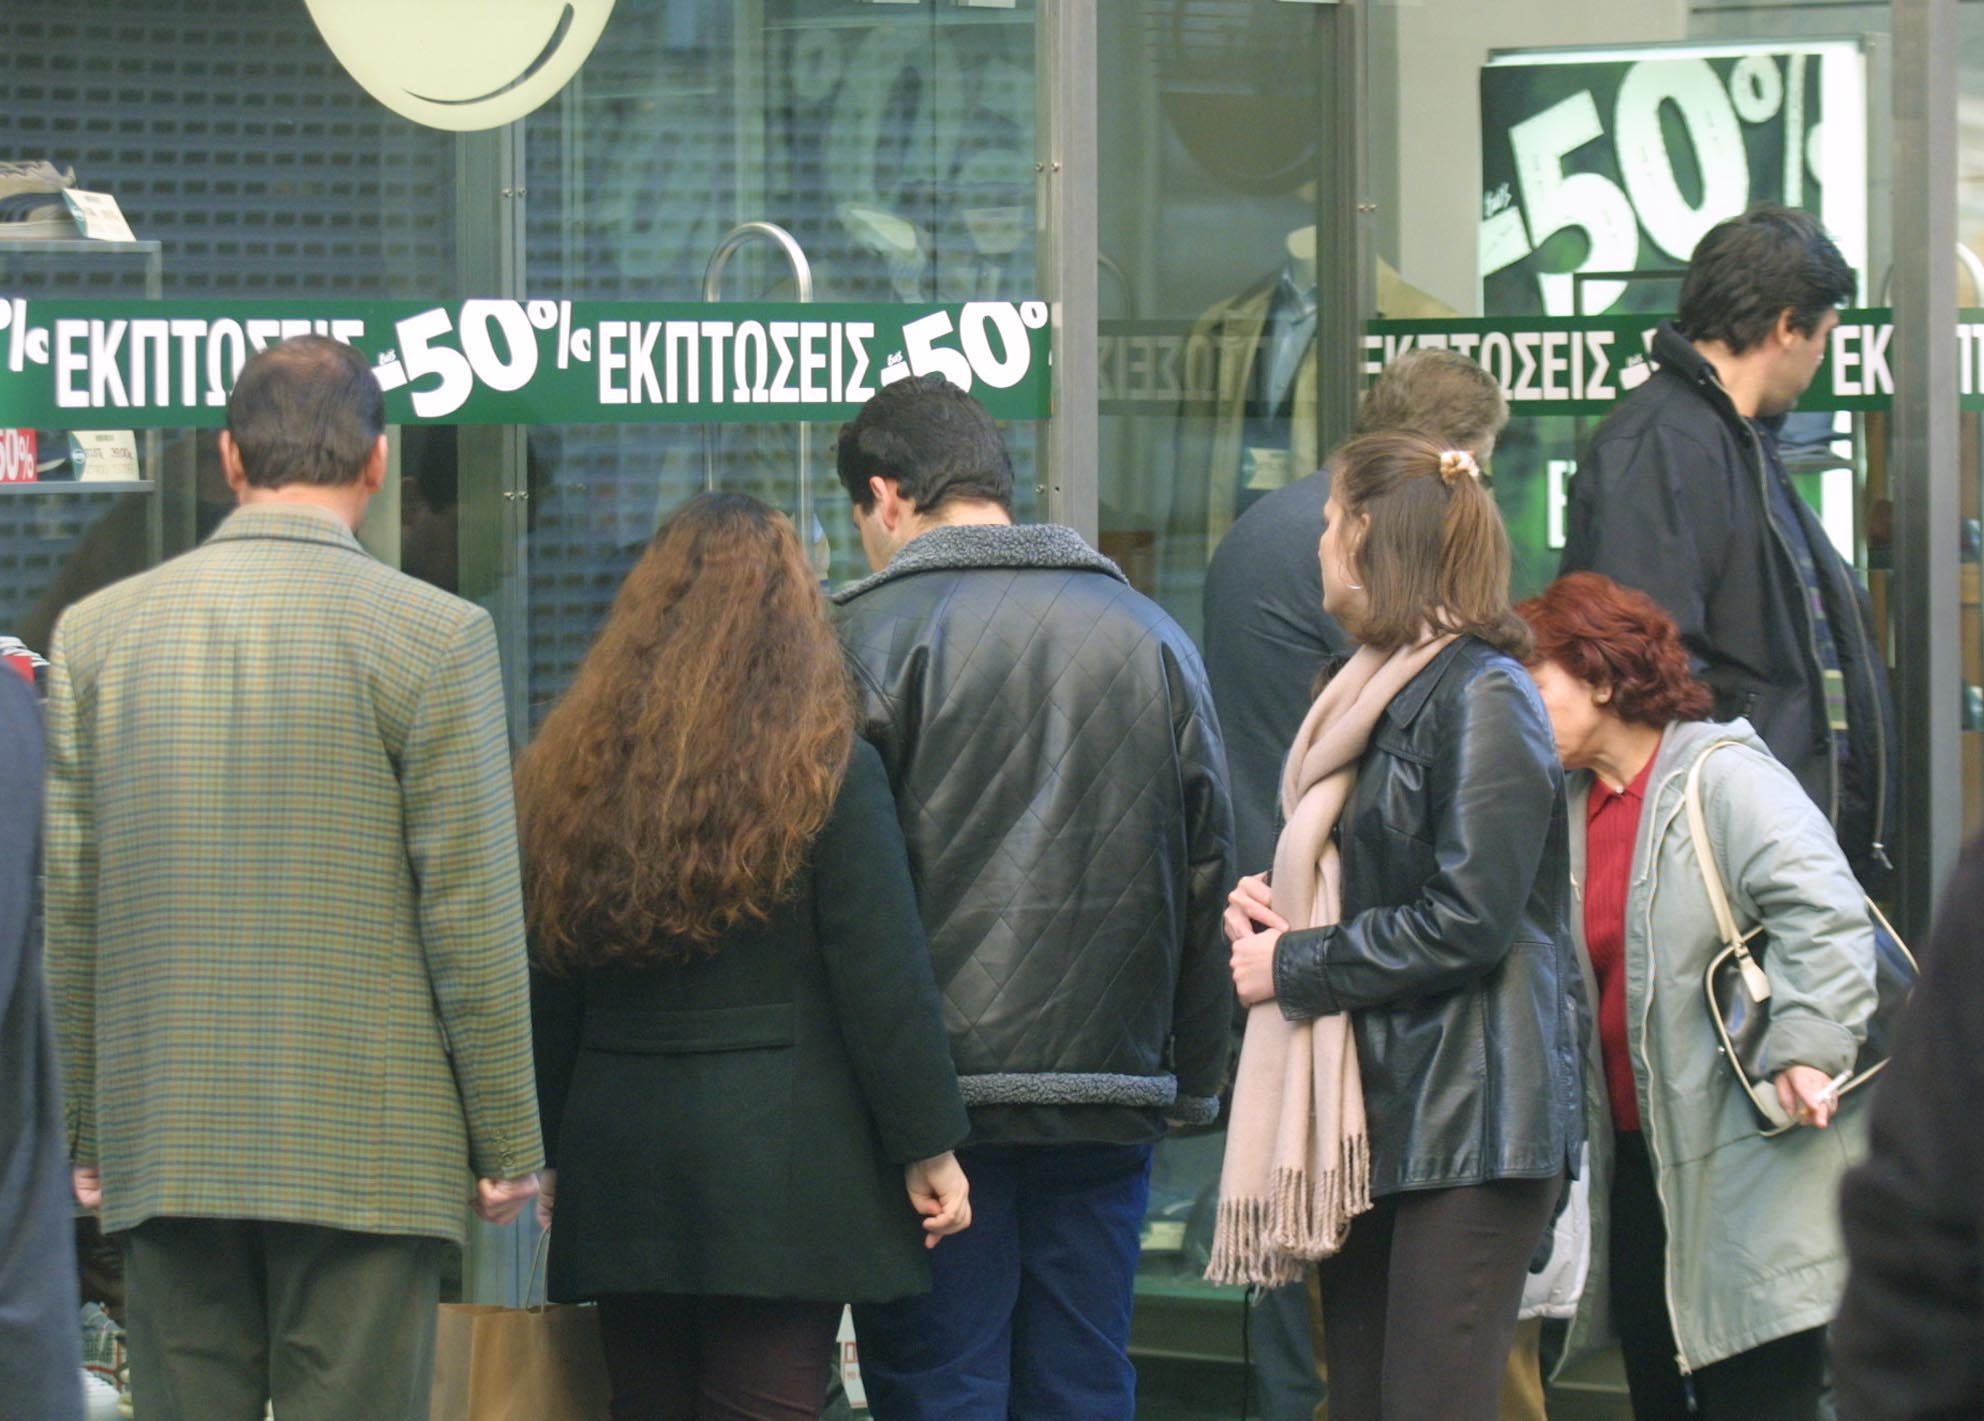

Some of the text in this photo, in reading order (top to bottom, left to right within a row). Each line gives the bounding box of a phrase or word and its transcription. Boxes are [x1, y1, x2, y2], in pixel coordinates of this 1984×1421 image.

[1479, 54, 1823, 317] -50%
[56, 318, 364, 407] ΕΚΠΤΩ
[372, 299, 592, 418] -50%
[599, 320, 876, 405] ΕΚΠΤΩΣΕΙΣ
[1360, 331, 1616, 401] ΕΩΣΕΙΣ
